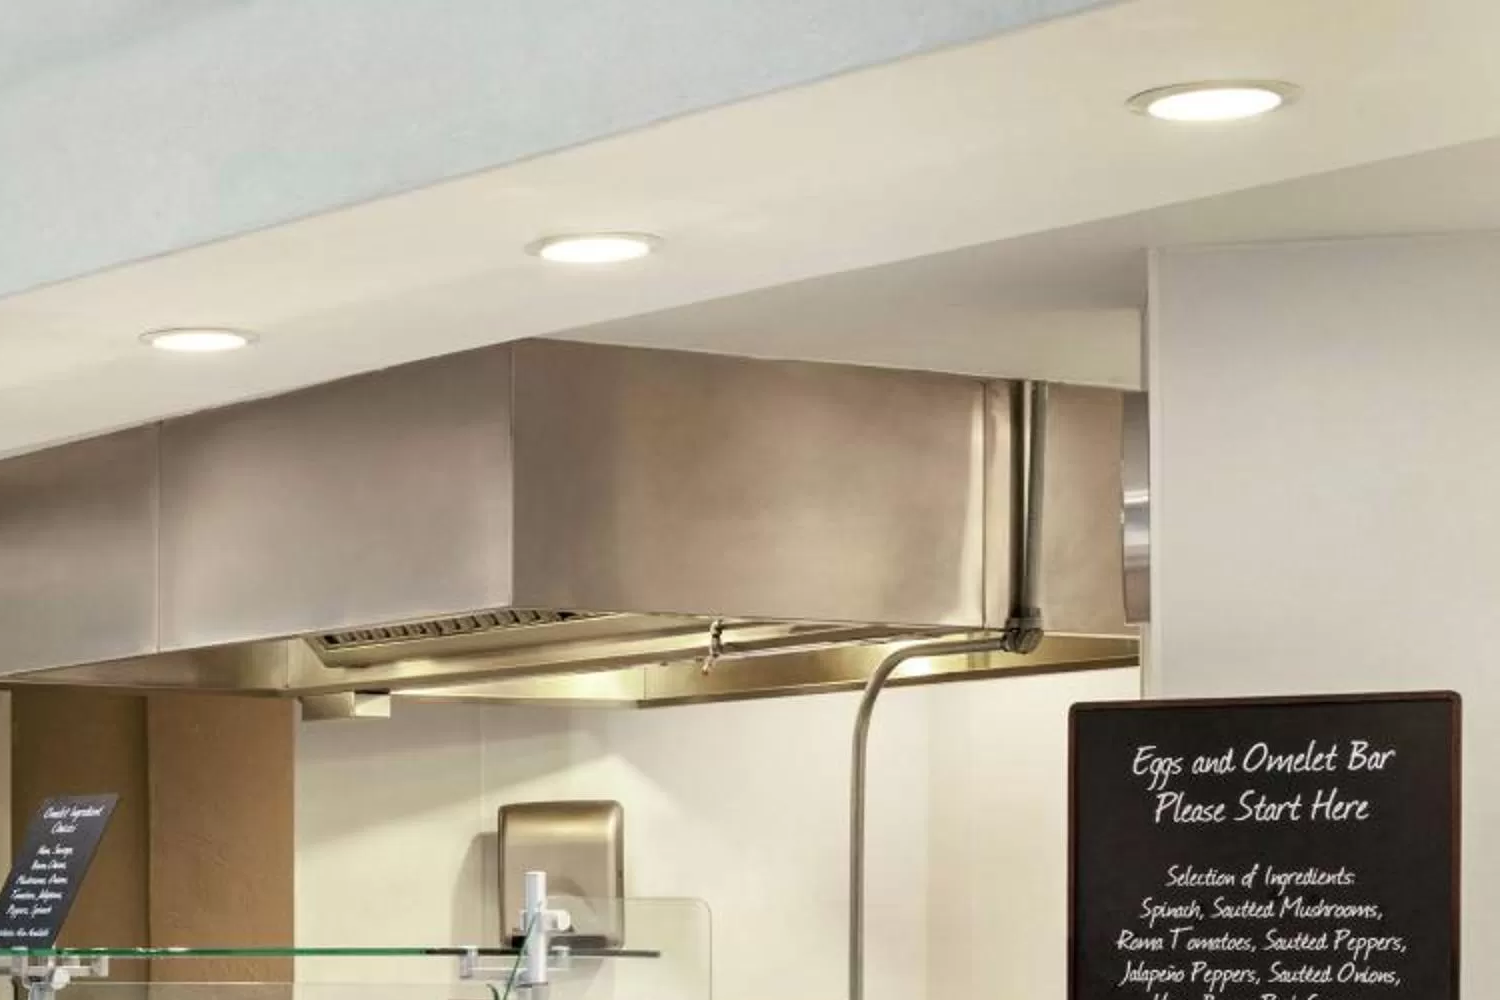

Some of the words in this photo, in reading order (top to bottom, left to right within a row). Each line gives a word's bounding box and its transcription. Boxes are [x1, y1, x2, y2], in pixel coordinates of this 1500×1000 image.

[1133, 746, 1183, 790] Eggs
[1192, 748, 1236, 774] and
[1243, 740, 1338, 773] Omelet
[1347, 740, 1396, 770] Bar
[1155, 792, 1225, 823] Please
[1234, 790, 1302, 821] Start
[1311, 787, 1369, 820] Here
[1166, 865, 1235, 886] Selection
[1241, 864, 1259, 888] of
[1140, 897, 1204, 928] Spinach,
[1279, 896, 1382, 920] Mushrooms,
[1116, 929, 1163, 950] Roma
[1334, 929, 1406, 961] Peppers,
[1191, 961, 1260, 992] Peppers,
[1337, 962, 1400, 986] Onions,
